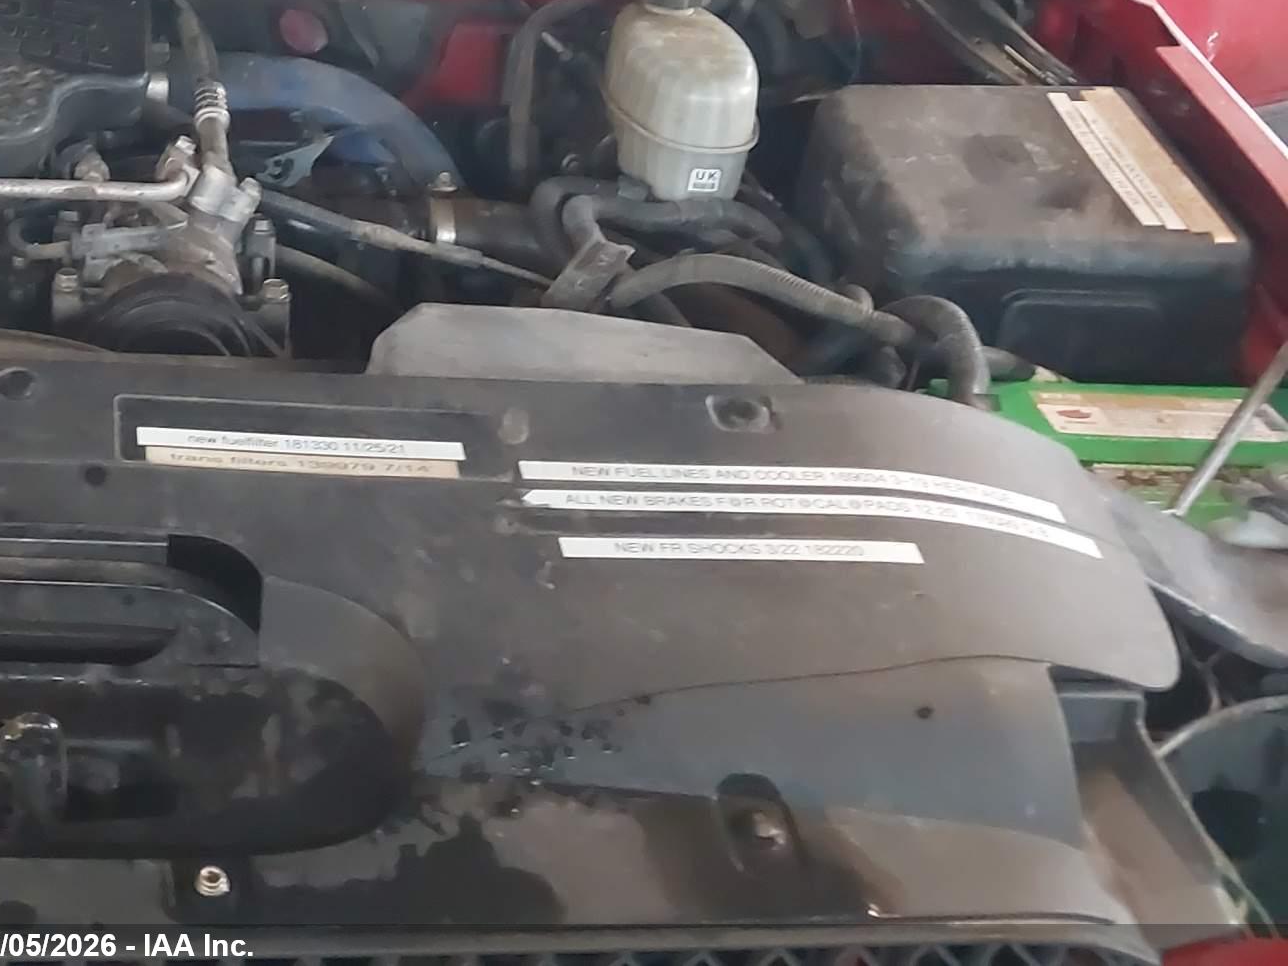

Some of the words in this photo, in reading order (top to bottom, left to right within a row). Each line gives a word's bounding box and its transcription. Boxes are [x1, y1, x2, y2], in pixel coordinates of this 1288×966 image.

[571, 466, 610, 476] NEW
[614, 467, 657, 478] FUEL
[662, 468, 710, 479] LINES
[715, 469, 749, 480] AND
[754, 470, 825, 481] COOLER
[565, 494, 597, 505] ALL
[600, 495, 638, 505] NEW
[643, 496, 713, 507] BRAKES
[614, 542, 654, 553] NEW
[659, 542, 682, 553] FR
[687, 543, 761, 554] SHOCKS
